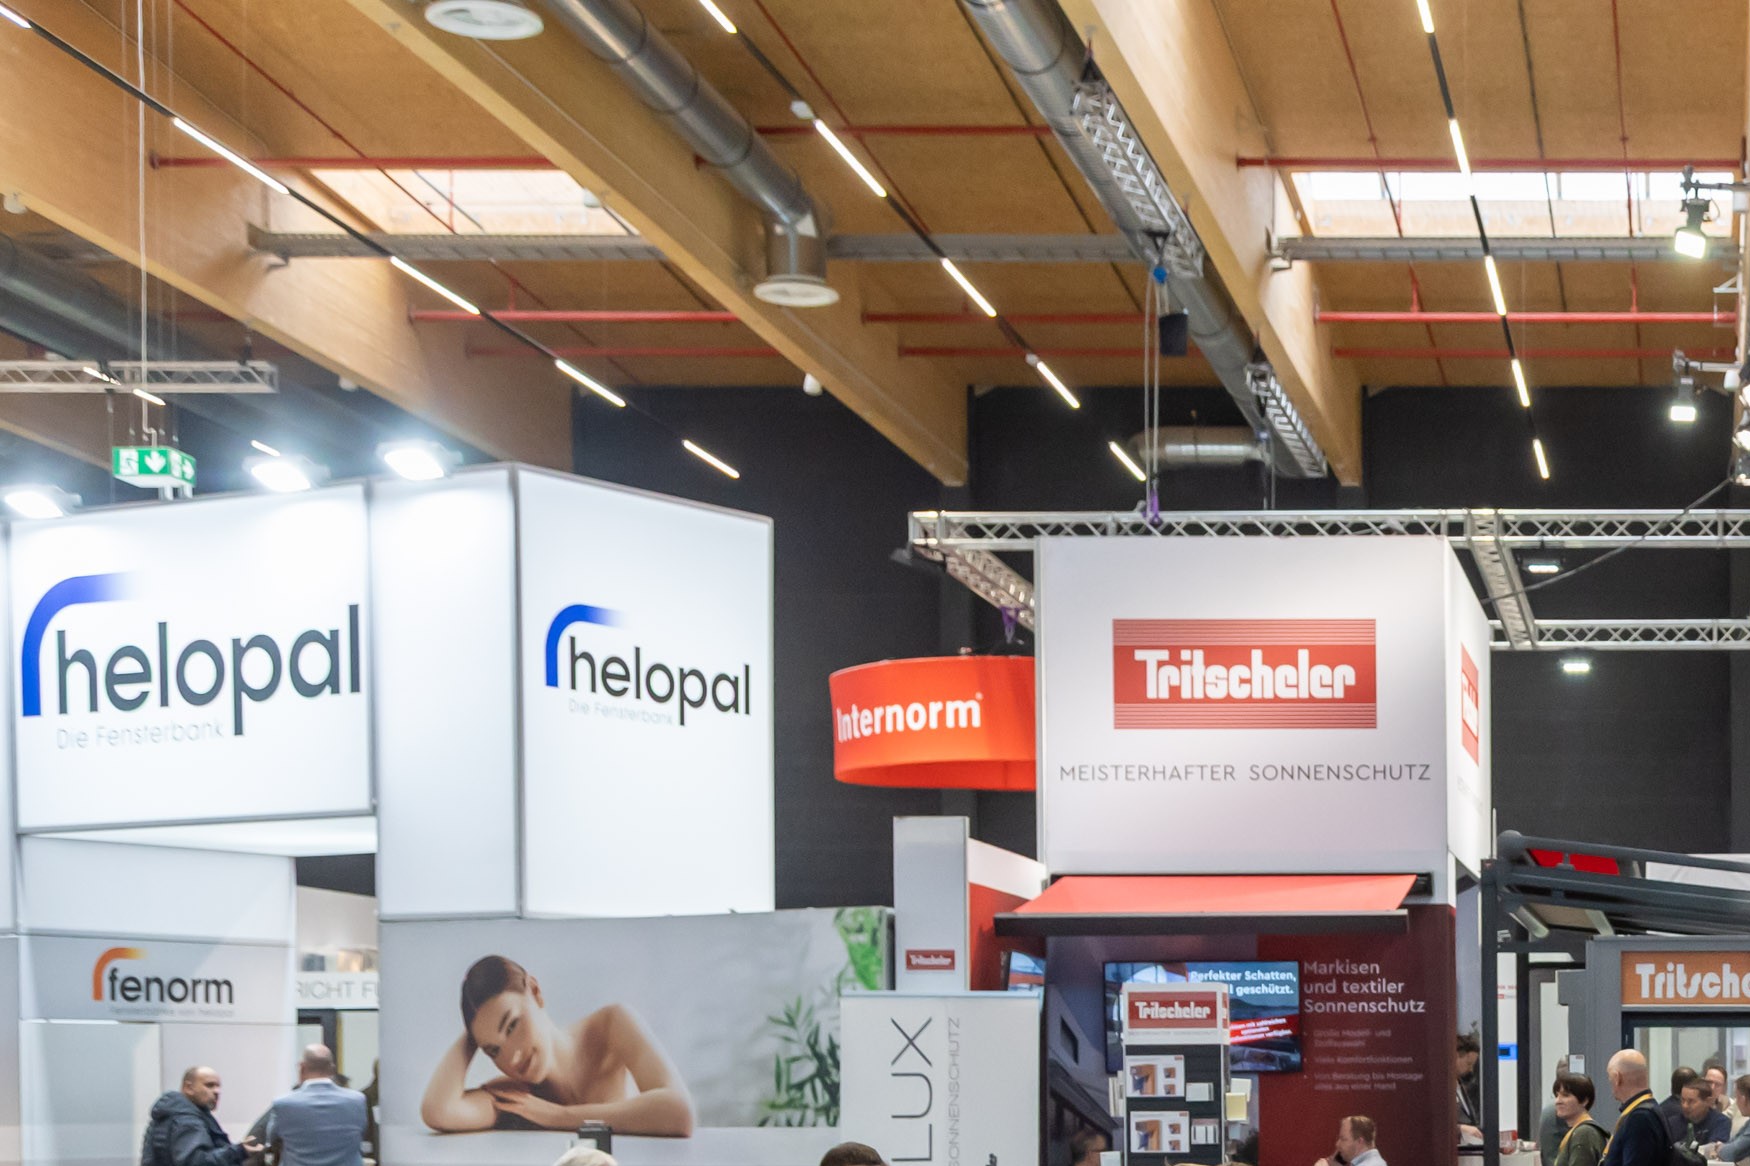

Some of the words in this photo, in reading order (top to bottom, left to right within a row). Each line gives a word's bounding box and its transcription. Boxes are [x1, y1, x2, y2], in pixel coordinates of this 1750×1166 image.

[56, 603, 361, 736] helopal
[1134, 648, 1356, 699] Tritscheler
[569, 635, 751, 726] helopal
[836, 698, 981, 743] Internorm
[56, 726, 90, 750] Die
[96, 718, 224, 747] Fensterbank
[1059, 764, 1236, 782] MEISTERHAFTER
[1249, 763, 1431, 782] SONNENSCHUTZ
[1190, 970, 1241, 982] Perfekter
[1244, 970, 1297, 982] Schatten,
[1304, 959, 1380, 975] Markisen
[109, 968, 234, 1004] fenorm
[1235, 984, 1294, 996] geschützt.
[1304, 979, 1337, 994] und
[1342, 978, 1404, 994] textiler
[1135, 1001, 1211, 1020] Tritscheler
[1304, 997, 1426, 1013] Sonnenschutz
